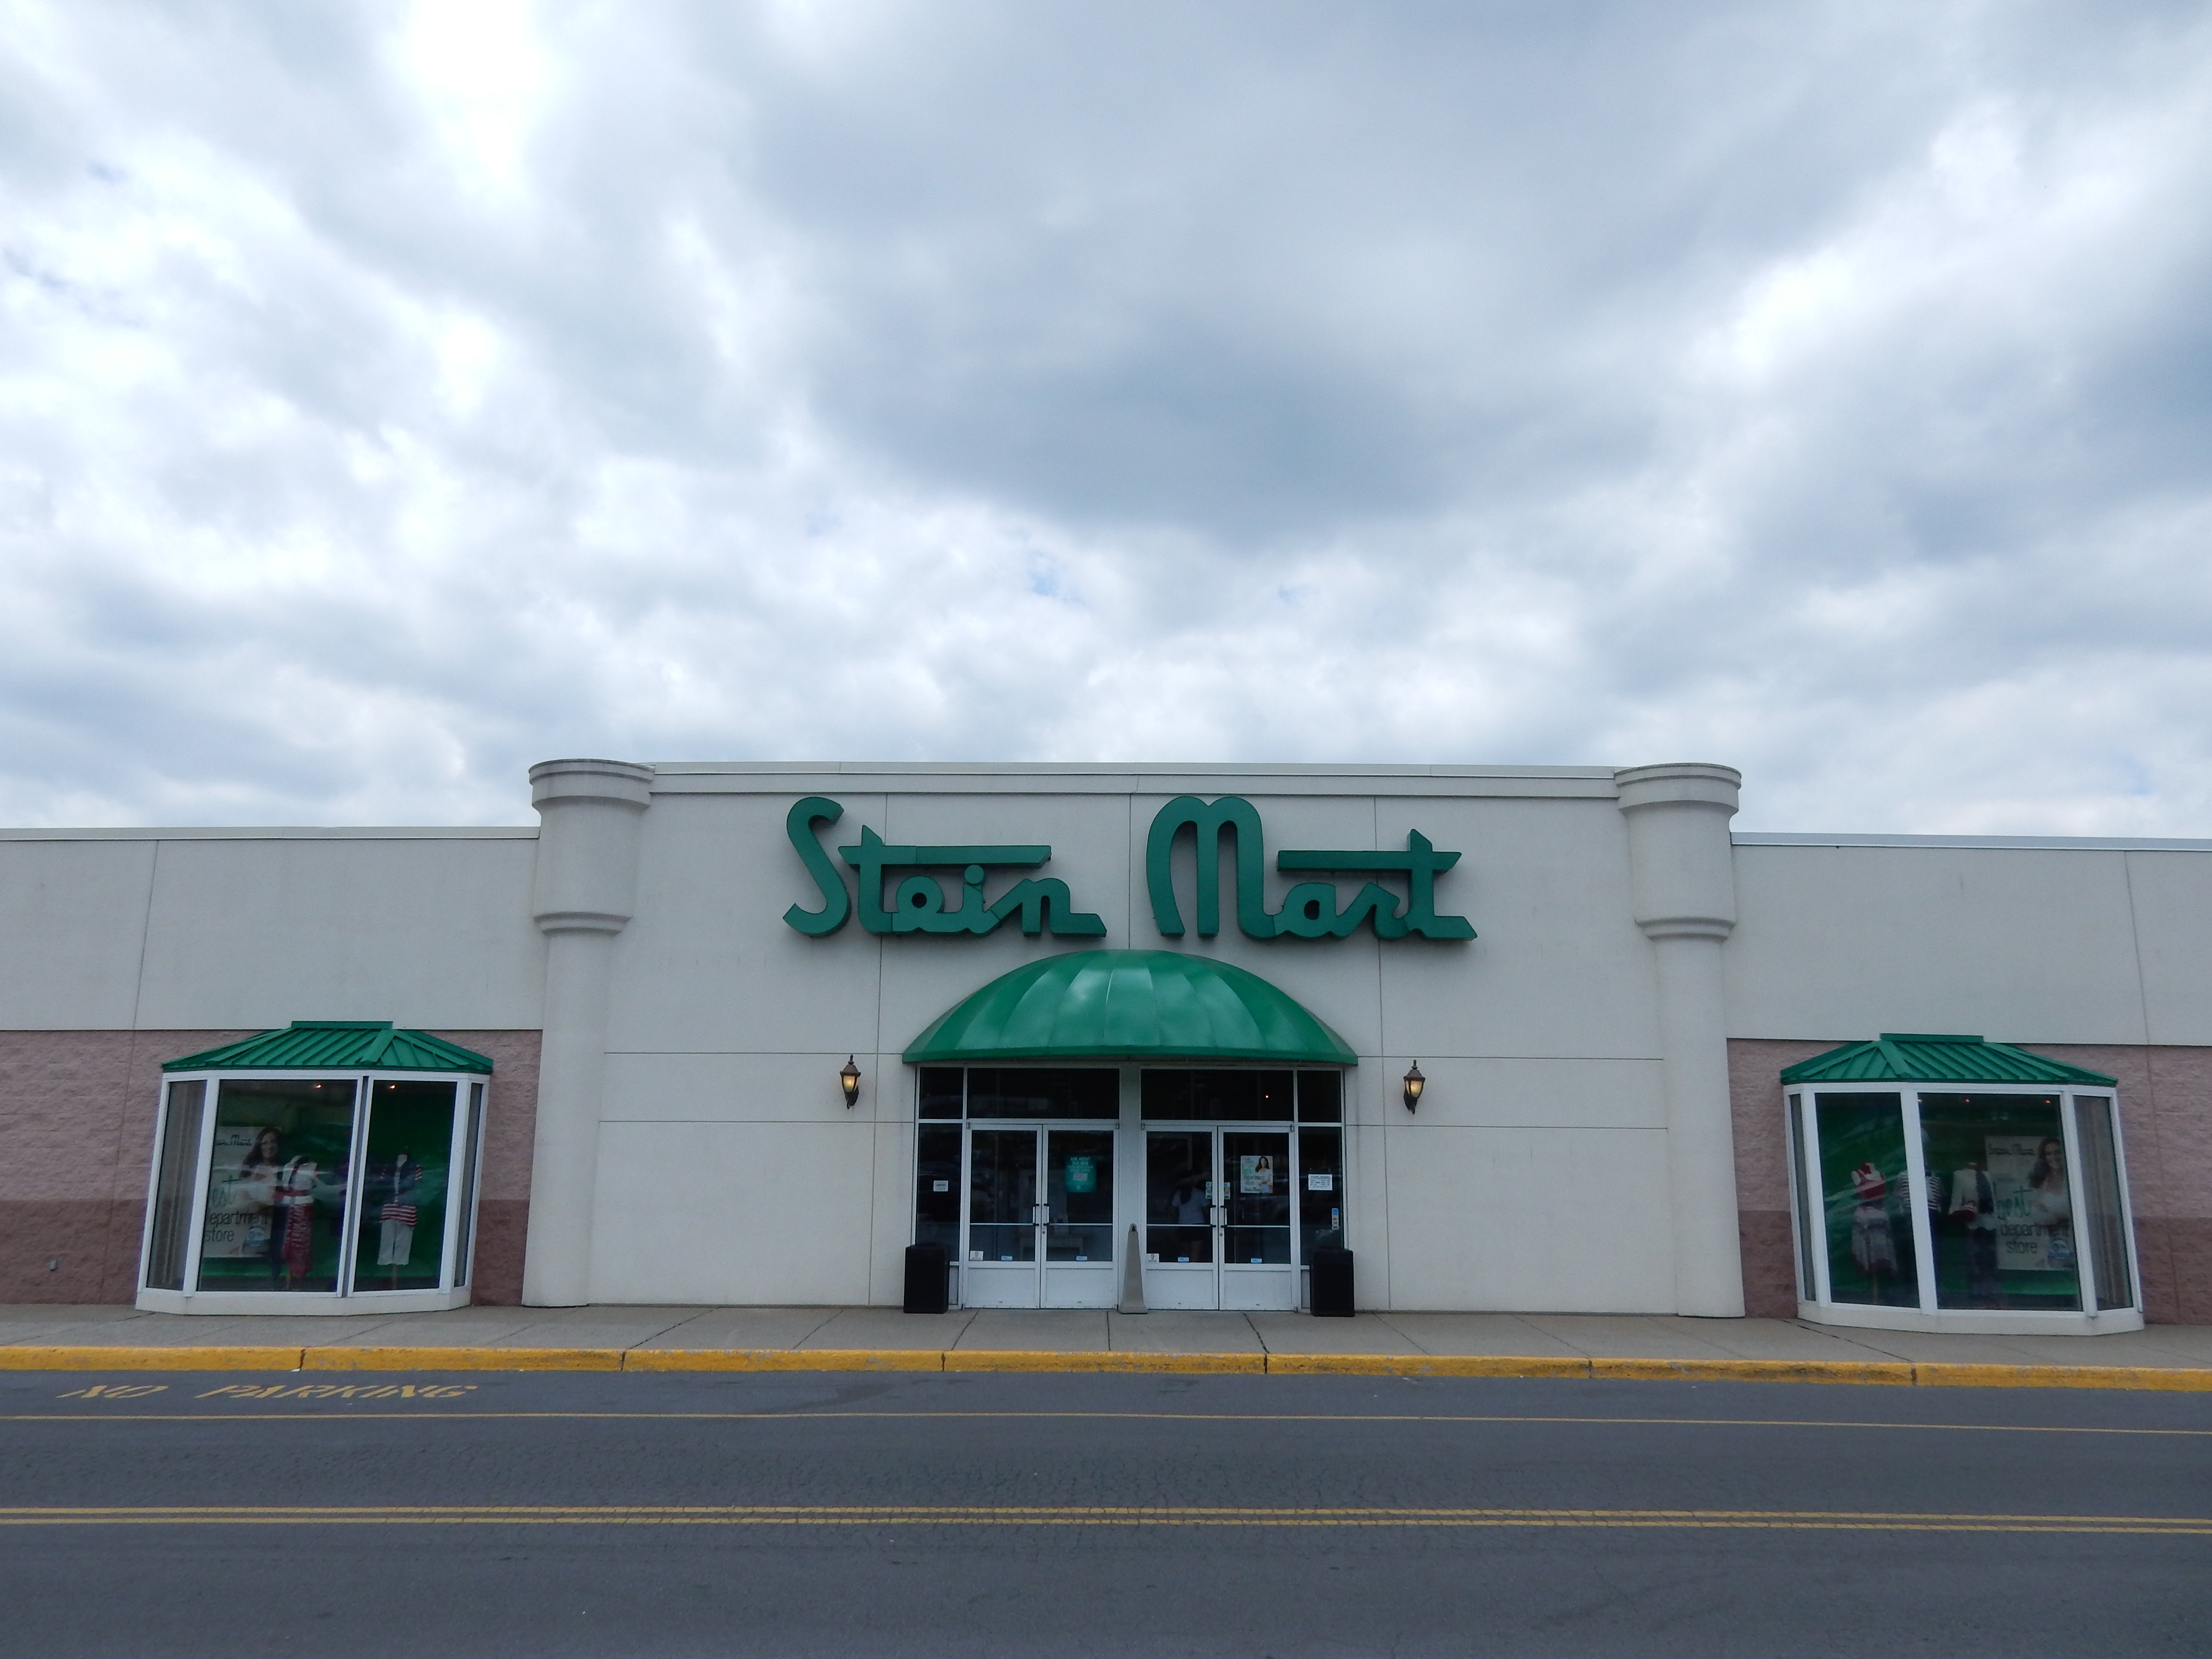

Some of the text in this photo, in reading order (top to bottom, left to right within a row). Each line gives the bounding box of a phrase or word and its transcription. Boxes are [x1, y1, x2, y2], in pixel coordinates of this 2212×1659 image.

[782, 796, 1478, 942] Stein Mart
[208, 1174, 242, 1208] est
[209, 1210, 268, 1227] epartment
[204, 1226, 235, 1242] store
[2006, 1239, 2038, 1254] store
[56, 1384, 478, 1399] NO PARKING
